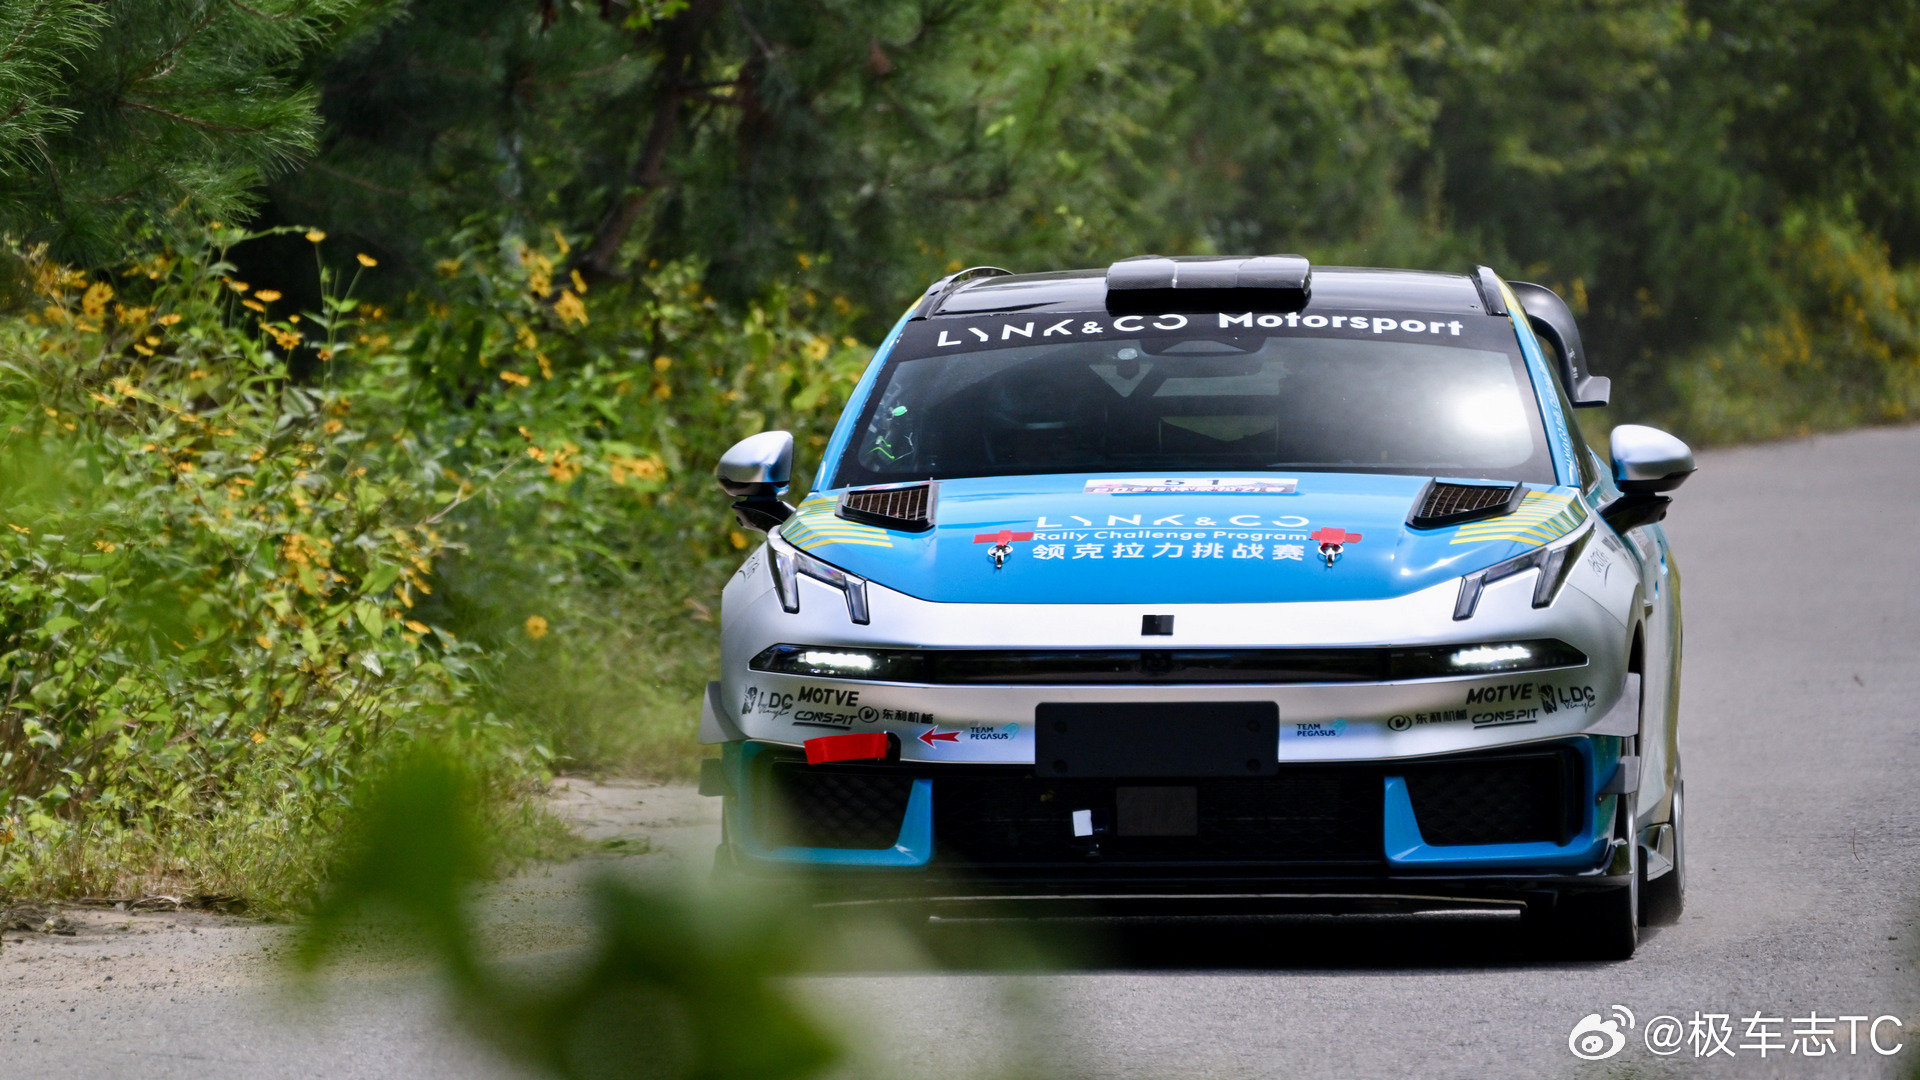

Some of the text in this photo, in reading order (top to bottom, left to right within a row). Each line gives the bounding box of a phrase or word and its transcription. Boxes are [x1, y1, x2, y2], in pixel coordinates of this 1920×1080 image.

[1218, 311, 1464, 336] Motorsport
[1032, 530, 1308, 542] Rally Challenge Program
[1032, 542, 1305, 561] 领克拉力挑战赛
[758, 691, 793, 709] LDC
[798, 686, 860, 707] MOTVE
[1466, 682, 1533, 705] MOTVE
[1558, 686, 1596, 704] LDC
[794, 710, 857, 725] CONSPIT
[1472, 708, 1539, 724] CONSPIT
